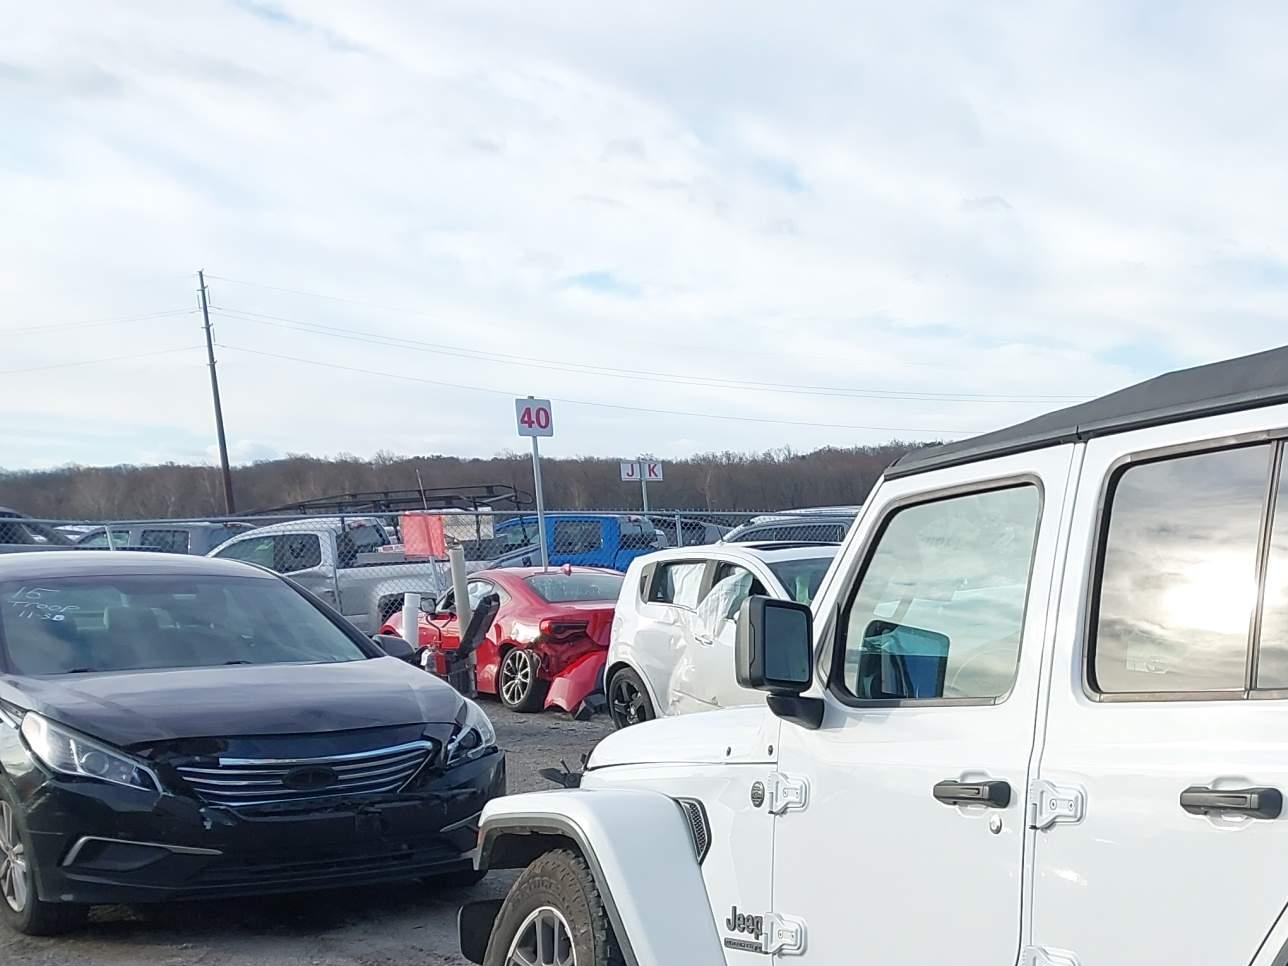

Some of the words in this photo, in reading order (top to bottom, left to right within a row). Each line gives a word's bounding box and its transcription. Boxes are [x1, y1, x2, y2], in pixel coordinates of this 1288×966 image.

[520, 407, 550, 428] 40
[626, 463, 635, 477] J
[648, 464, 658, 477] K
[726, 906, 763, 940] Jeep
